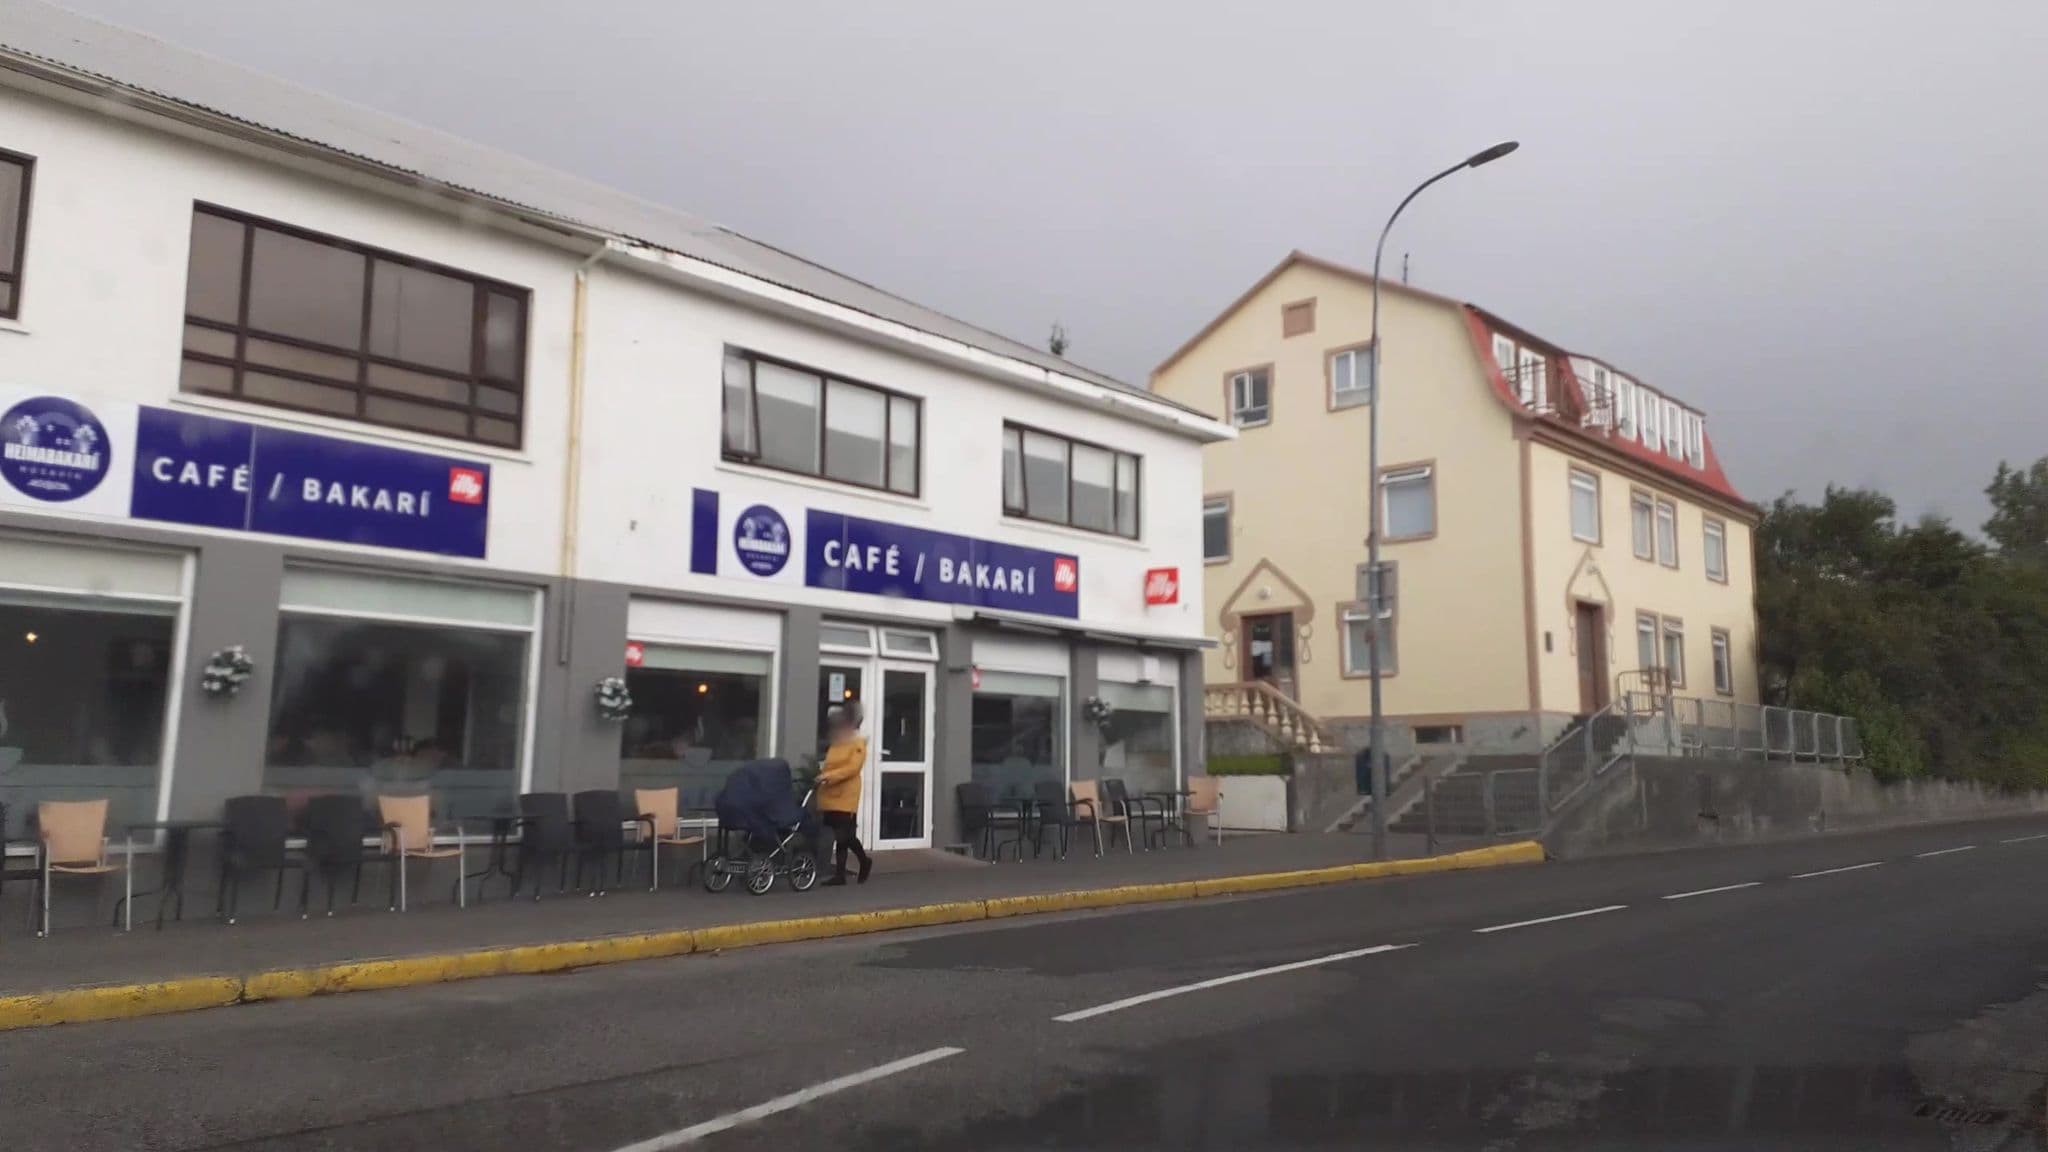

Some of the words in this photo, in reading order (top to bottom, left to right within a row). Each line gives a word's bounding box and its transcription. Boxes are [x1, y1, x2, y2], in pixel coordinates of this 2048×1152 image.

[152, 456, 251, 492] CAFÉ
[268, 472, 283, 500] /
[303, 478, 430, 516] BAKARÍ
[824, 540, 901, 575] CAFÉ
[912, 553, 927, 584] /
[939, 557, 1038, 595] BAKARÍ
[1054, 563, 1076, 589] illy
[1147, 572, 1177, 601] illy
